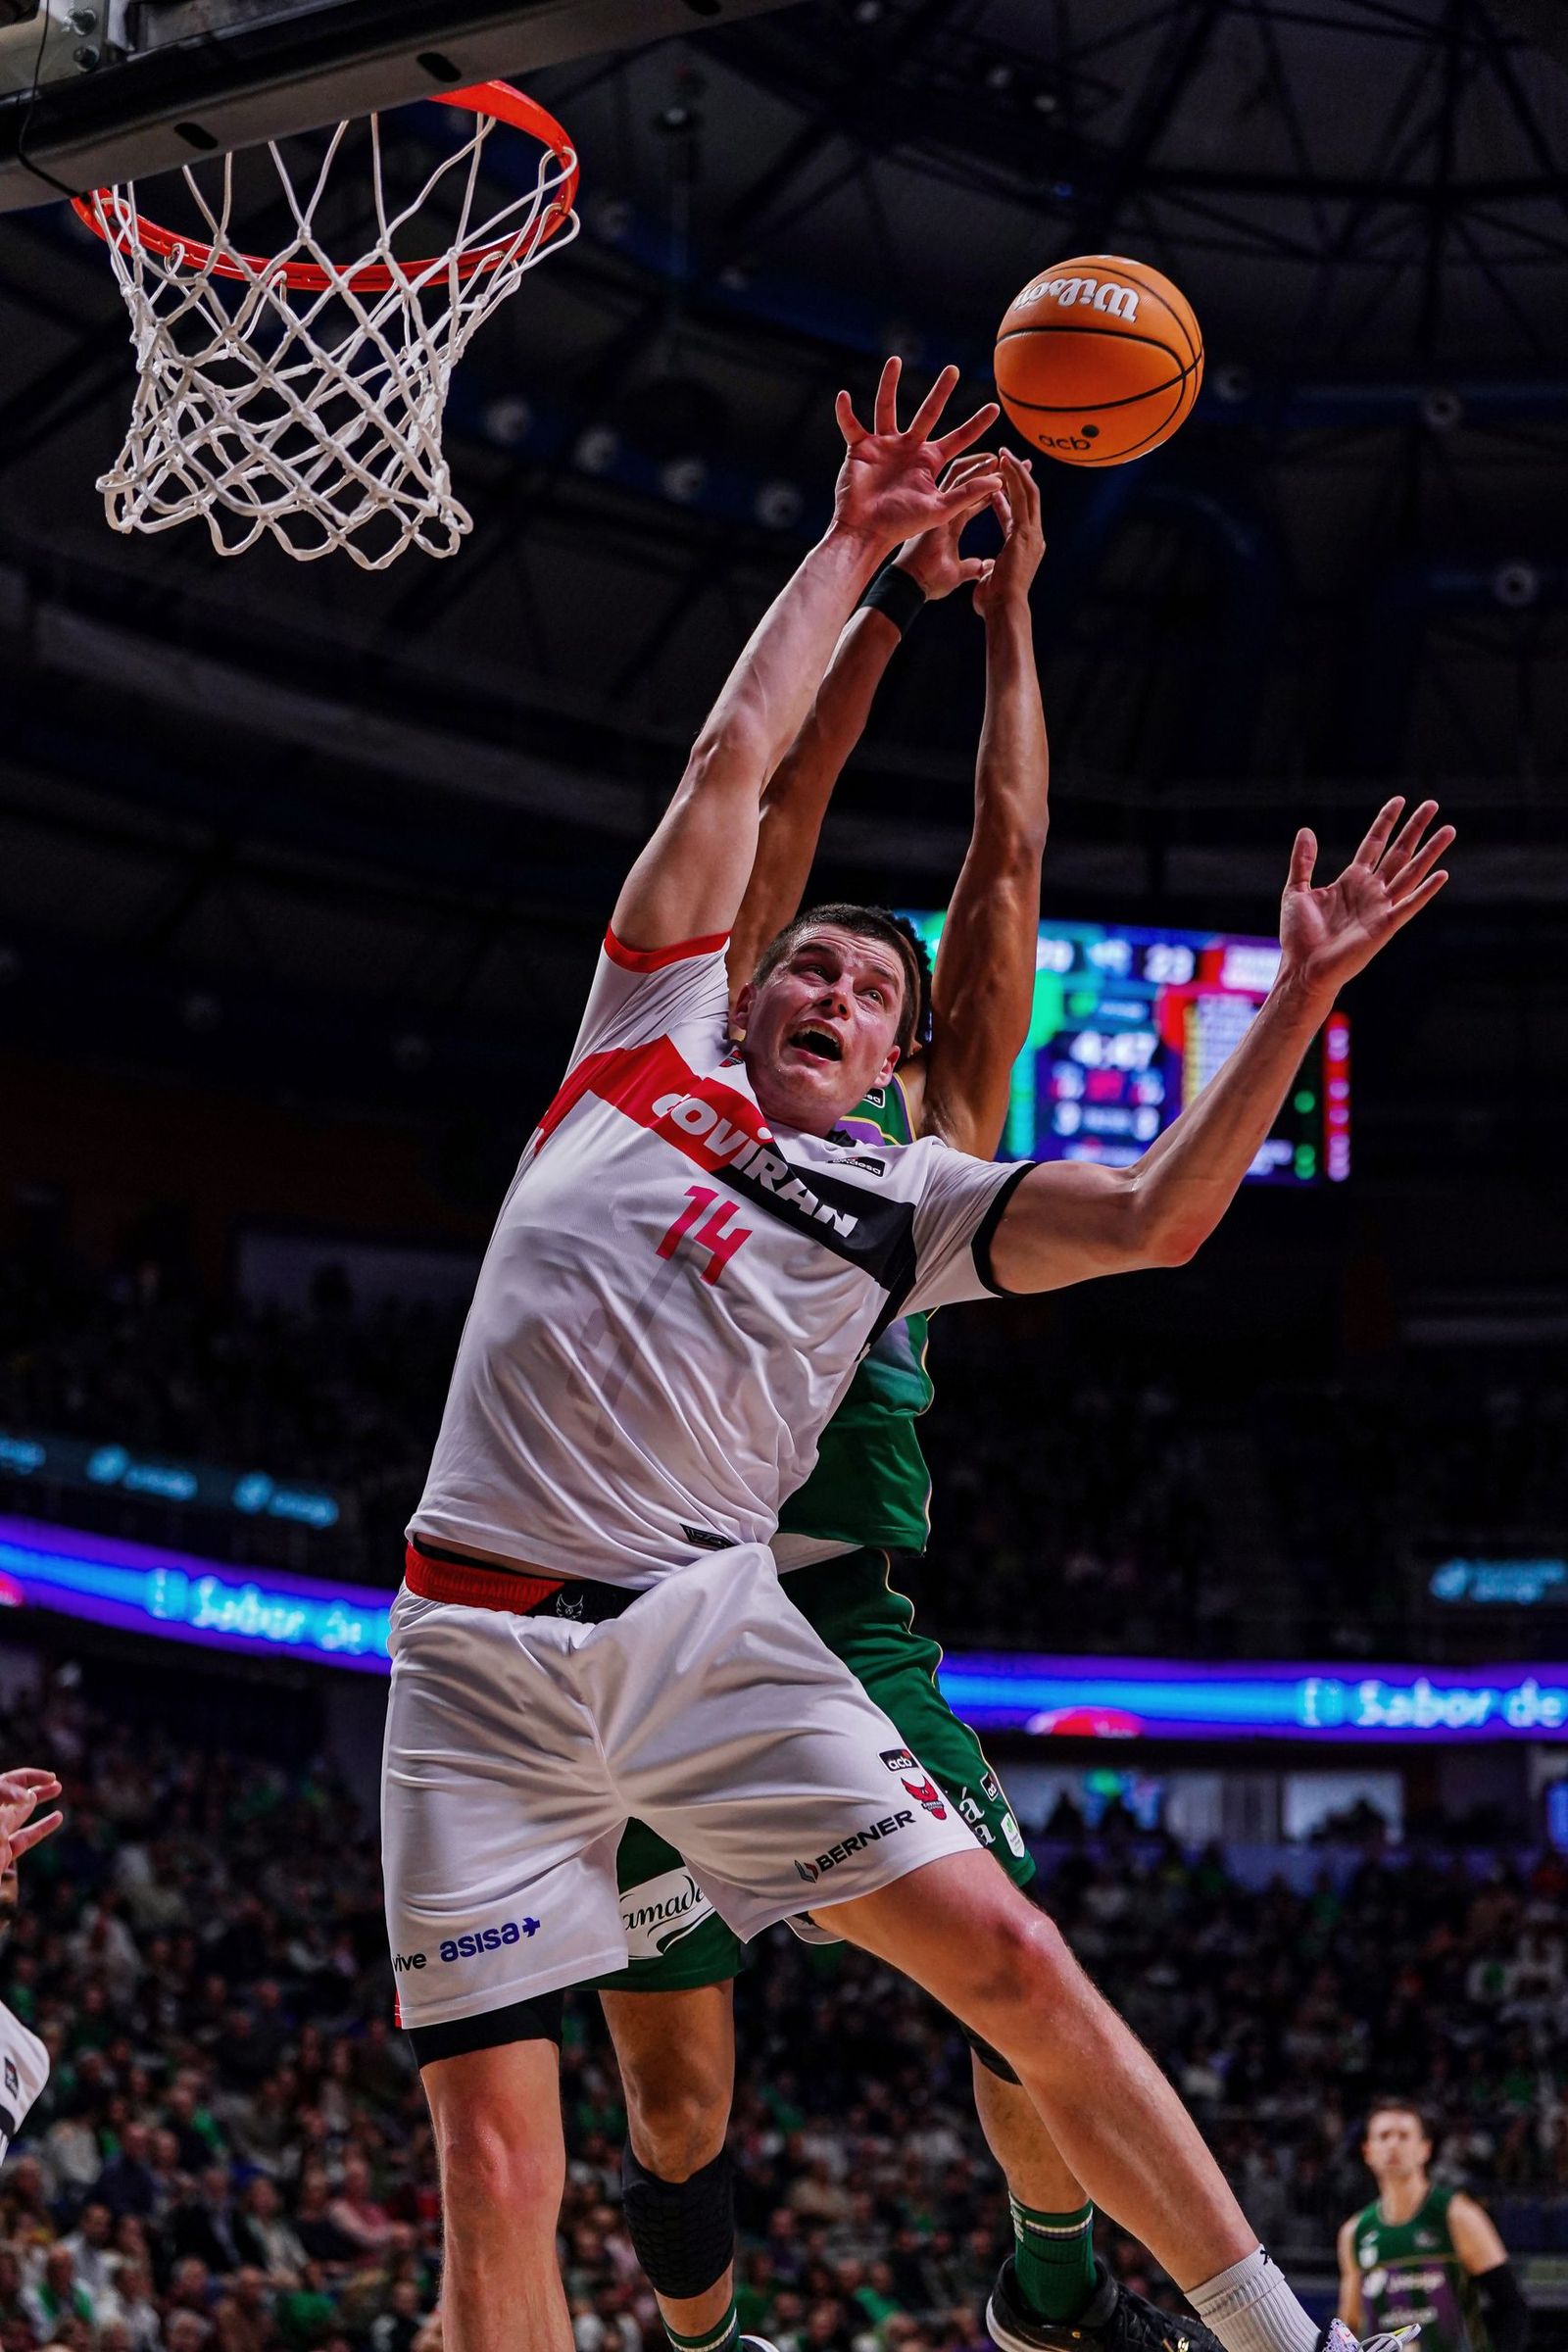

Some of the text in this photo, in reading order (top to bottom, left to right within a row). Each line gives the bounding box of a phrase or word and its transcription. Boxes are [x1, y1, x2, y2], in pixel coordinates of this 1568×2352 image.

[1038, 433, 1092, 451] acb
[656, 1185, 753, 1286] 14
[1356, 1677, 1492, 1729] Sabor
[888, 1756, 913, 1770] acb
[814, 1810, 917, 1874] BERNER
[439, 1922, 520, 1963] asisa
